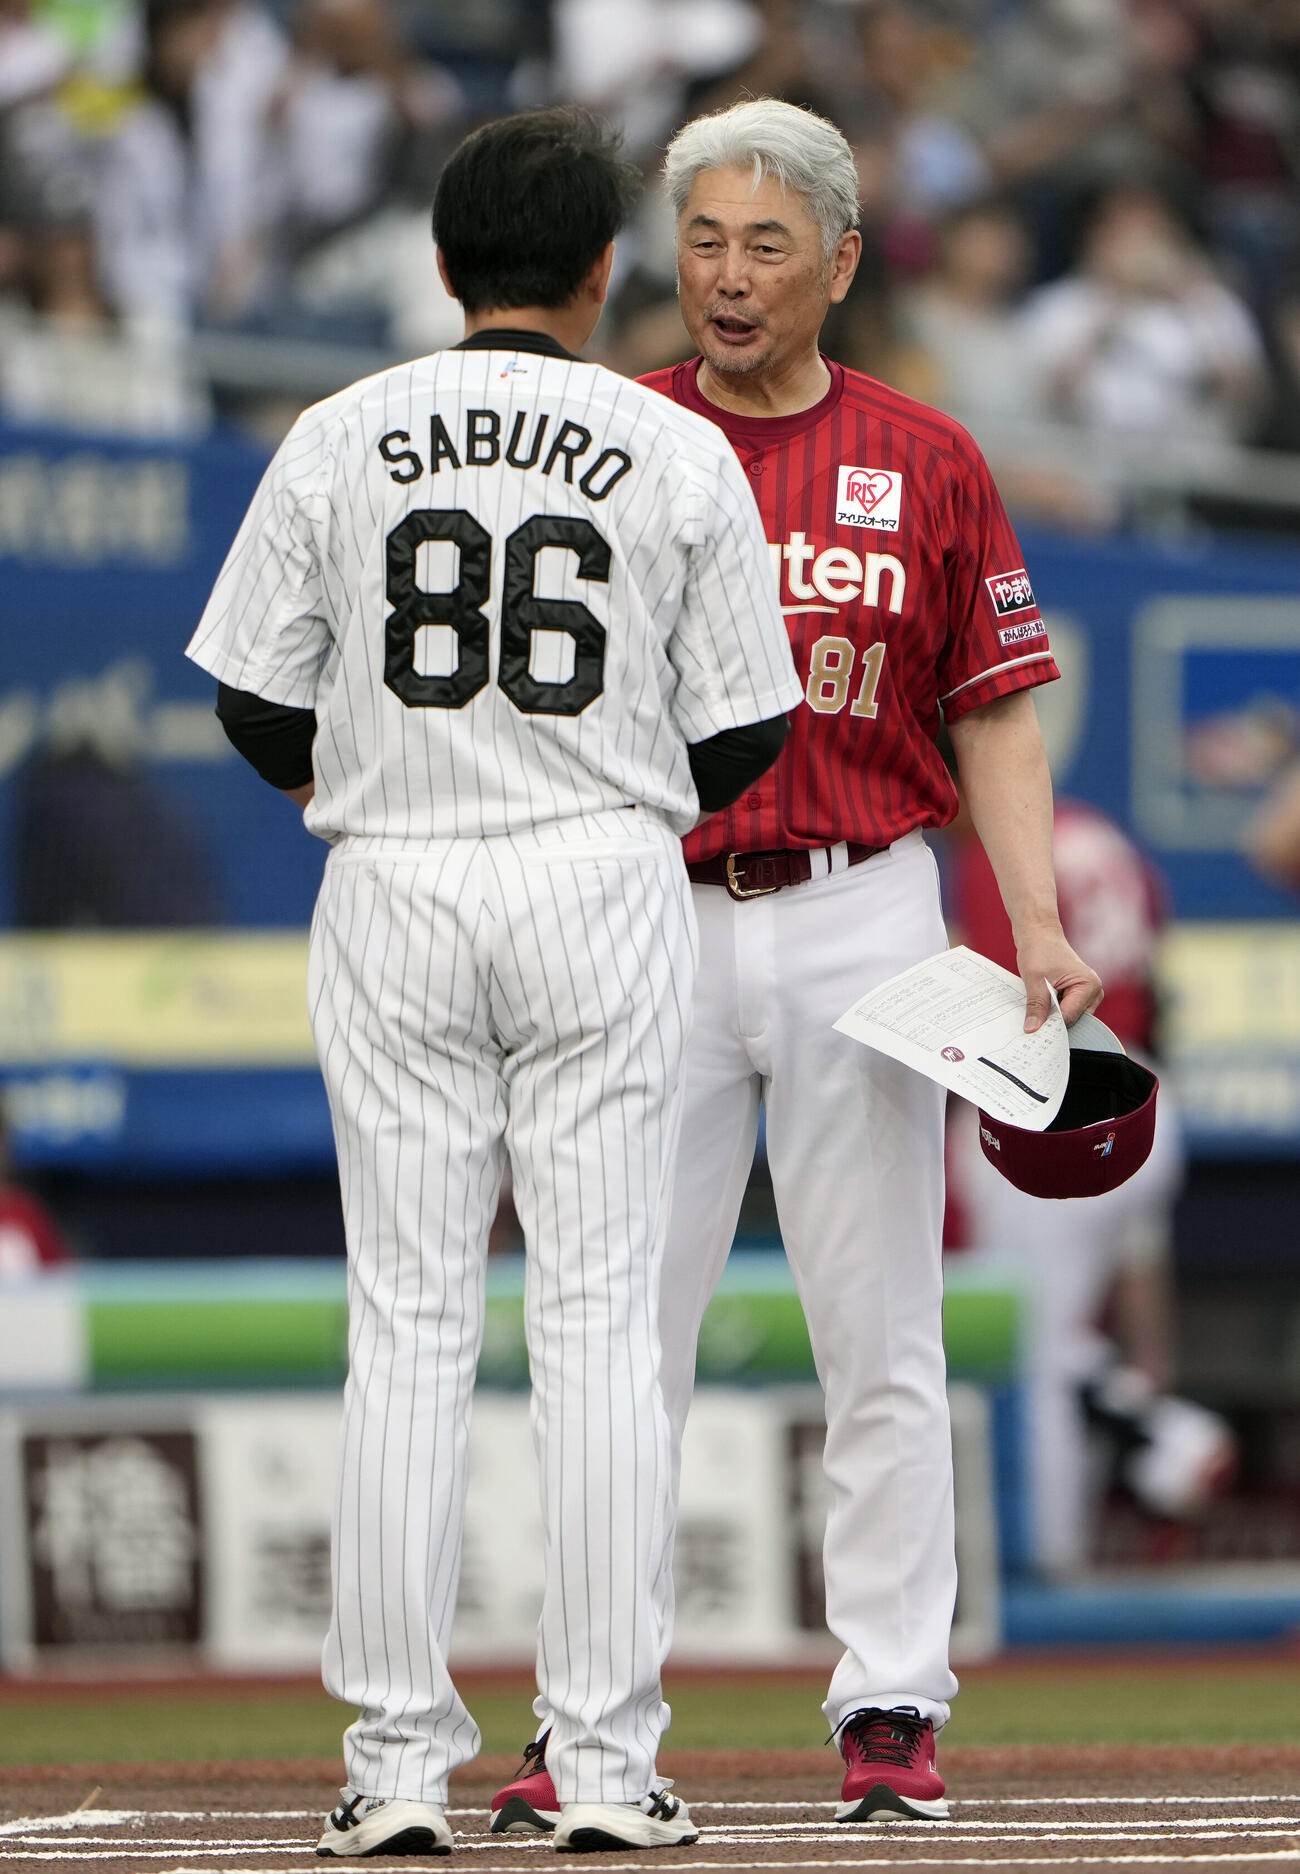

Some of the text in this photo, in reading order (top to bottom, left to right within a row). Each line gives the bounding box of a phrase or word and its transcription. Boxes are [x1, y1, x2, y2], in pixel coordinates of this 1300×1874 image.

[378, 408, 633, 502] SABURO
[837, 512, 898, 530] アイリスオーヤマ
[383, 508, 613, 718] 86
[994, 575, 1032, 609] やまや
[805, 634, 887, 720] 81
